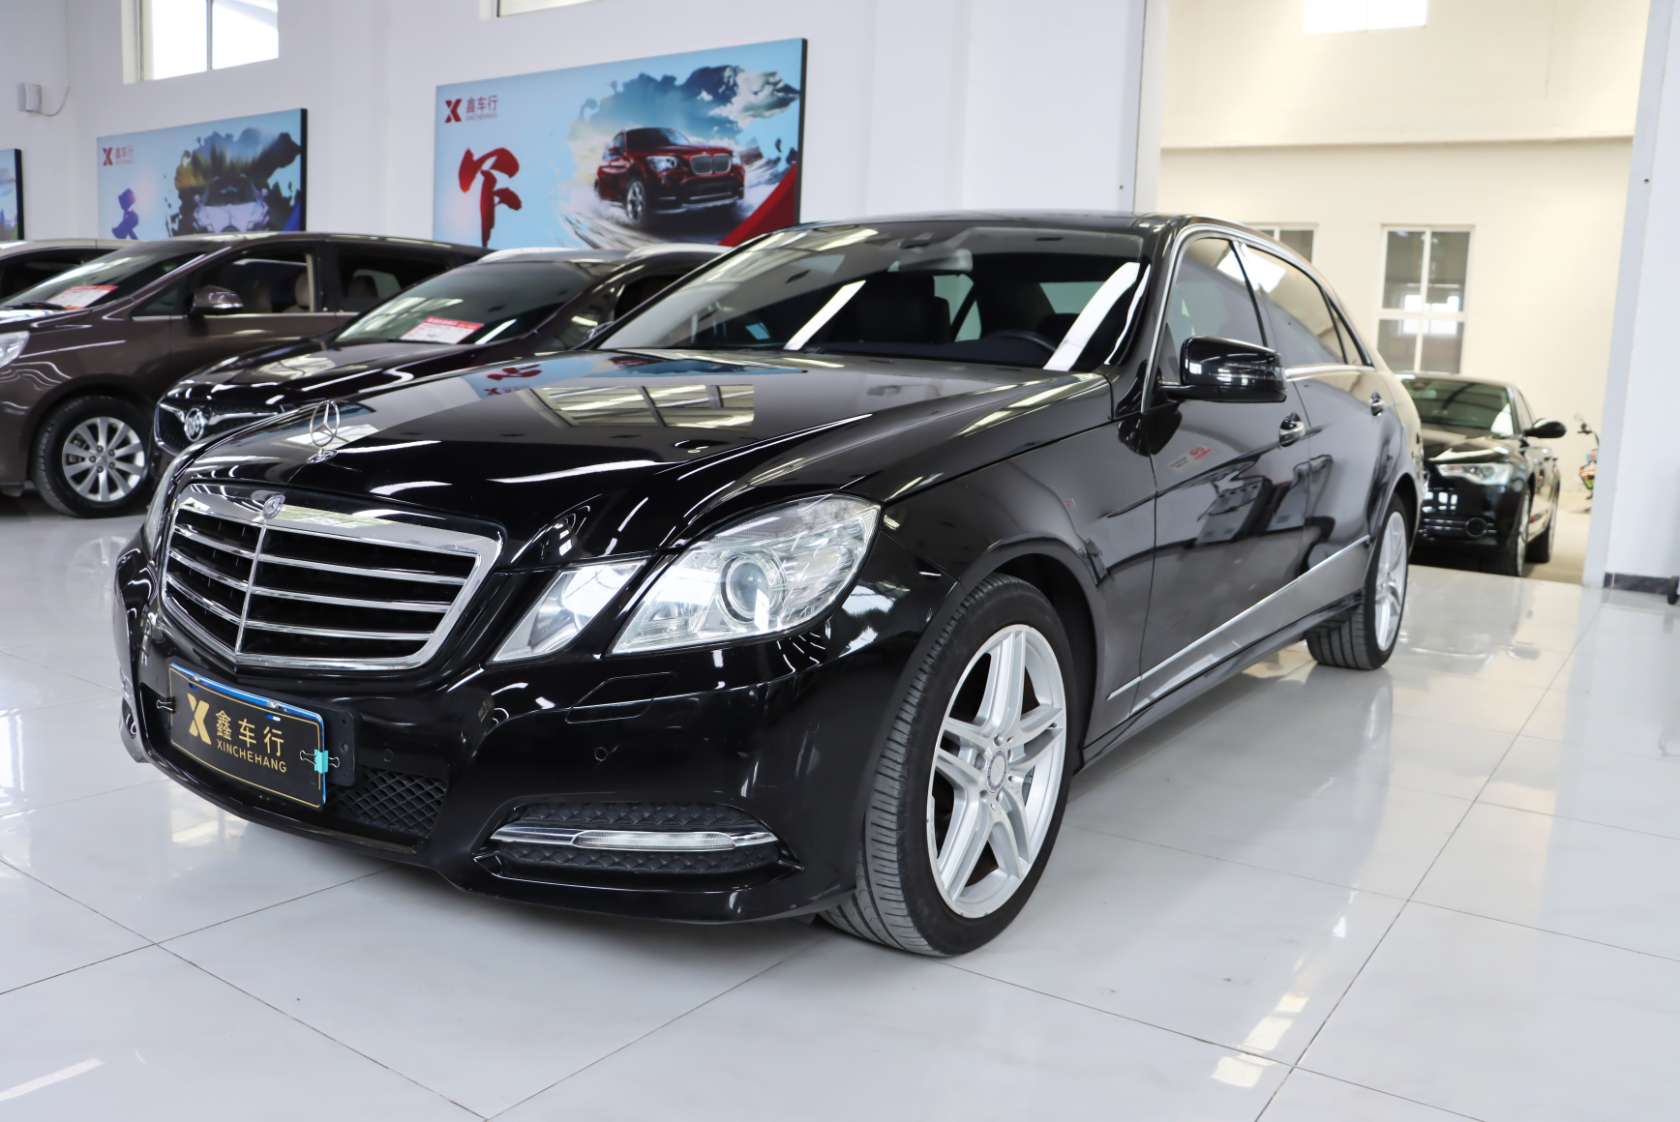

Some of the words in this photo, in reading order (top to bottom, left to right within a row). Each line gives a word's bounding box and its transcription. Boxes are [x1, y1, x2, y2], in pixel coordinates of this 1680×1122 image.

[216, 709, 284, 757] 鑫车行
[216, 740, 288, 773] XINCHEHANG
